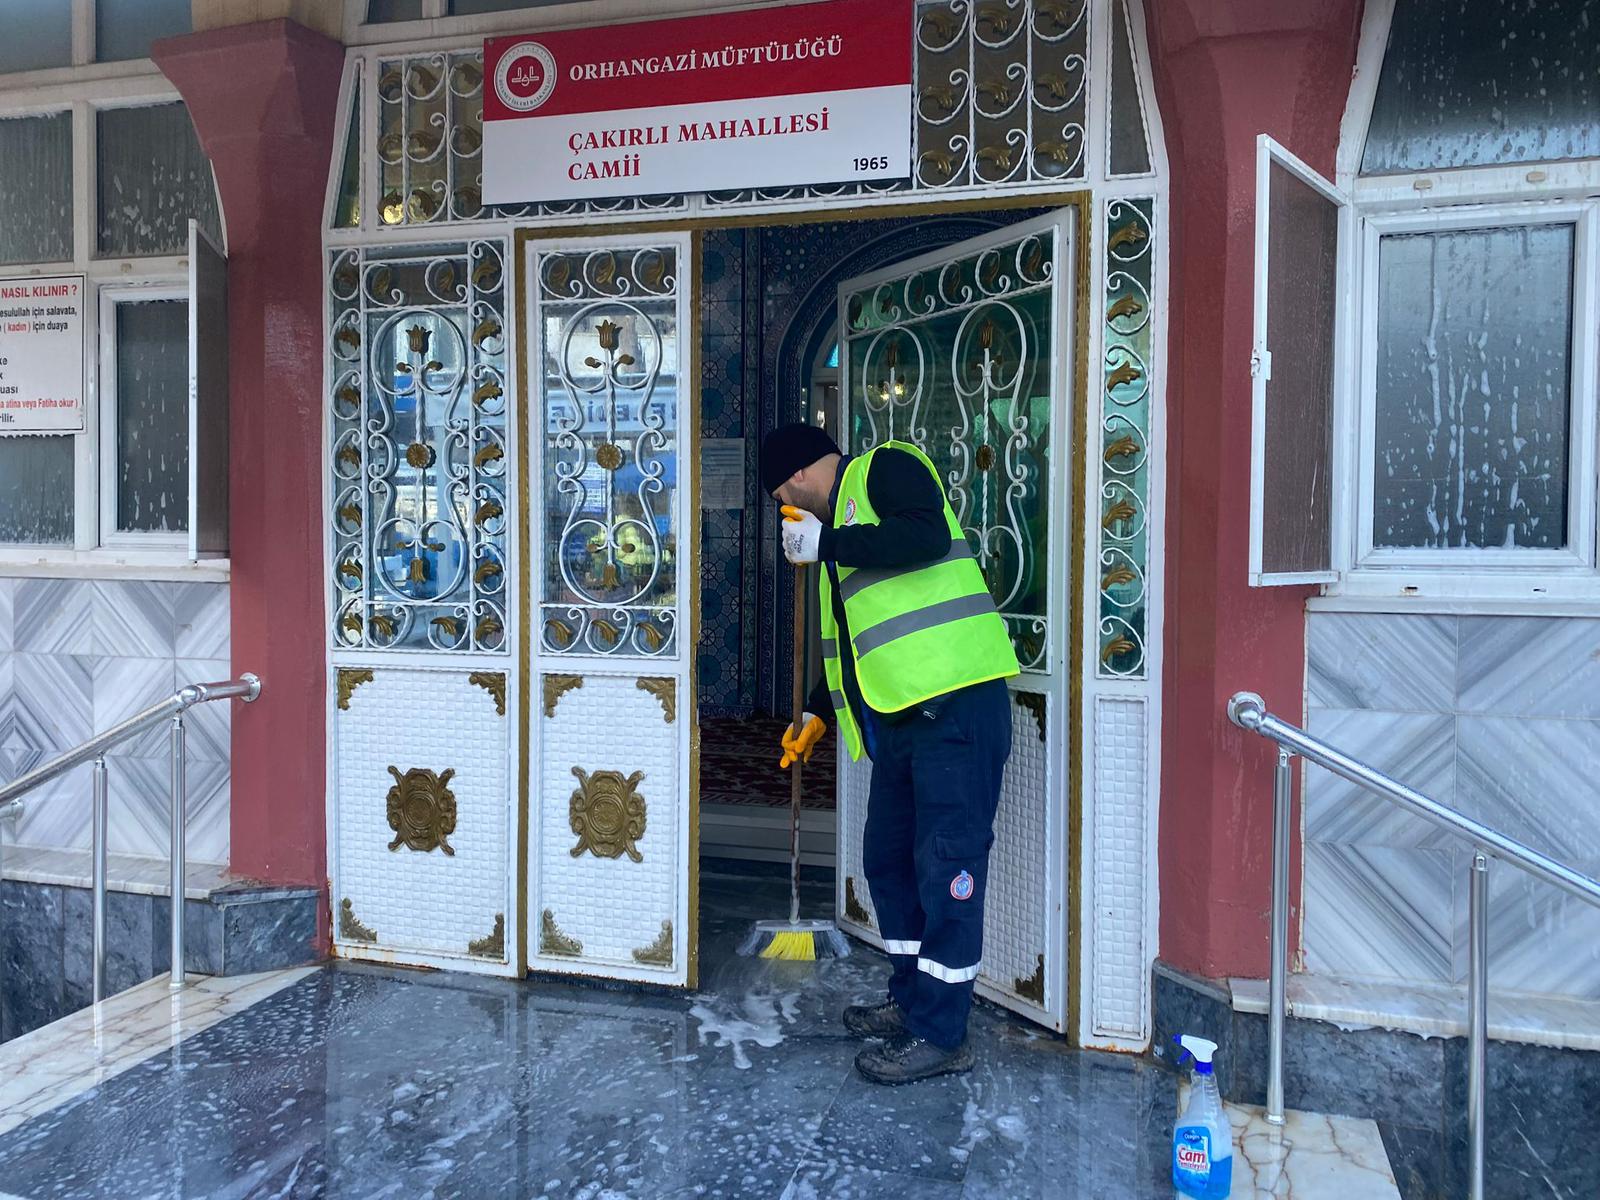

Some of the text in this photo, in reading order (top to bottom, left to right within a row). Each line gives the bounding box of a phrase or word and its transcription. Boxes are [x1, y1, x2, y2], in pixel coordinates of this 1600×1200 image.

[569, 34, 843, 81] ORHANGAZİ MÜFTÜLÜĞÜ
[568, 107, 830, 156] ÇAKIRLI MAHALLESİ
[568, 153, 641, 181] CAMİİ
[853, 156, 889, 171] 1965
[1, 284, 78, 299] NASIL KILINIR ?
[32, 306, 45, 319] için
[46, 305, 78, 317] salavata,
[7, 322, 27, 332] kadın
[32, 321, 46, 334] için
[46, 320, 69, 333] duaya
[21, 400, 37, 411] veya
[58, 397, 74, 408] okur
[1178, 1147, 1206, 1164] Cam
